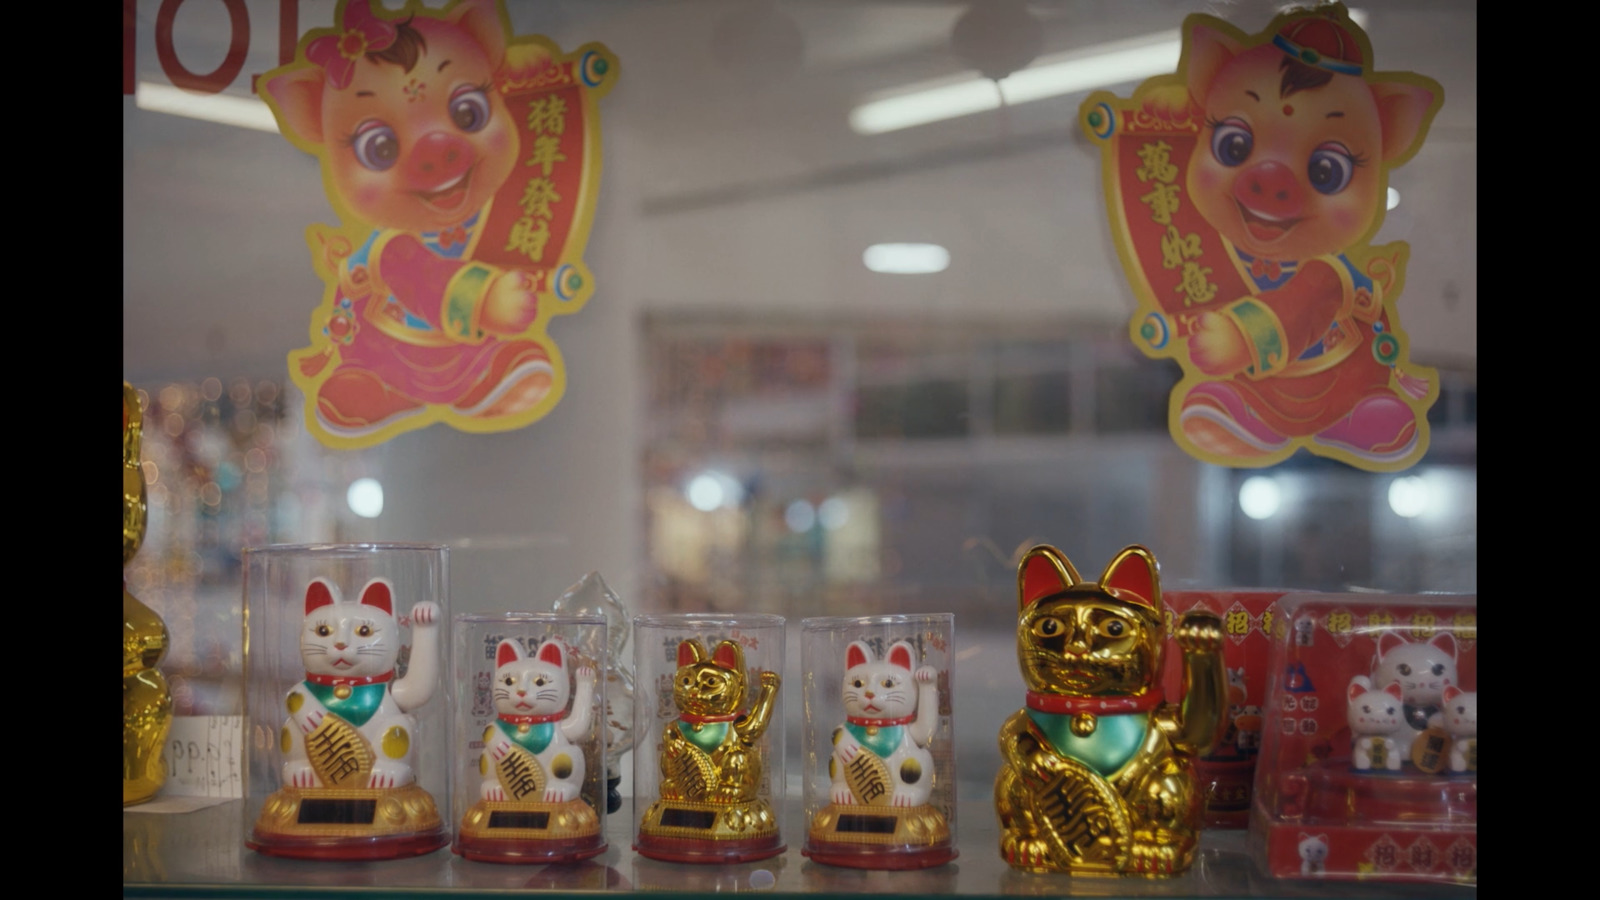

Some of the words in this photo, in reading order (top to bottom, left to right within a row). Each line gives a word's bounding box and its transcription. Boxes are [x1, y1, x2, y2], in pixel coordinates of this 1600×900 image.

[504, 94, 570, 264] 猪年發財
[1136, 139, 1218, 308] 萬事如意
